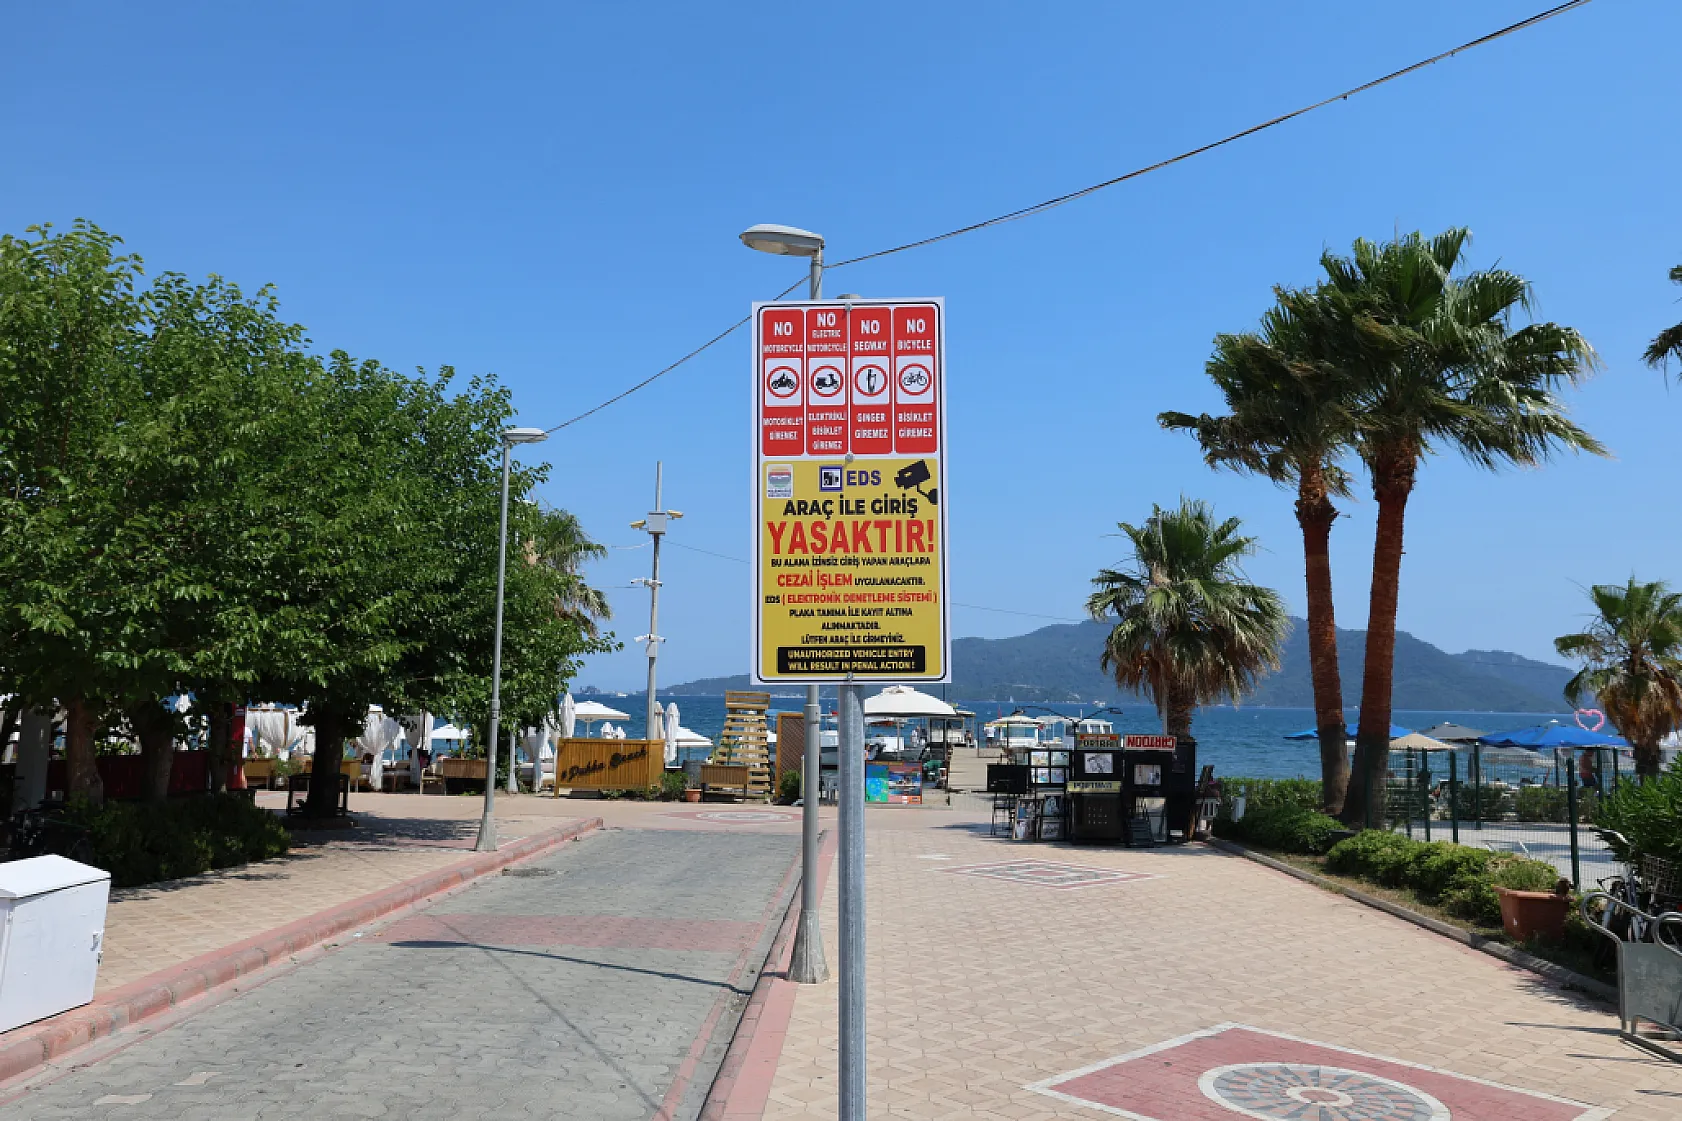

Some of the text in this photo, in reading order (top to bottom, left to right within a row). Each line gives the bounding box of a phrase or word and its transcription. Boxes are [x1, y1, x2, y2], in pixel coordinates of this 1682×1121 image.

[816, 312, 836, 327] NO
[774, 321, 793, 336] NO
[861, 319, 880, 334] NO
[906, 318, 926, 334] NO
[812, 329, 841, 338] ELECTRIC
[763, 344, 803, 353] MOTORCYCLE
[807, 343, 847, 352] MOTORCYCLE
[854, 341, 887, 351] SEGWAY
[897, 339, 932, 350] BICYCLE
[898, 411, 933, 422] BİSİKLET
[855, 427, 888, 439] GİREMEZ
[898, 426, 933, 438] GİREMEZ
[846, 470, 881, 486] EDS
[783, 493, 919, 519] ARAÇ İLE GİRİŞ
[767, 520, 934, 555] YASAKTIR!
[771, 558, 782, 567] BU
[784, 558, 810, 567] ALANA
[777, 569, 813, 587] CEZAİ
[816, 568, 853, 590] İŞLEM
[765, 594, 780, 604] EDS
[789, 608, 815, 617] PLAKA
[787, 648, 915, 659] UNAUTHORIZED VEHICLE ENTRY
[788, 662, 808, 671] WILL
[810, 661, 840, 671] RESULT
[841, 661, 850, 670] IN
[851, 661, 878, 670] PENAL
[1125, 736, 1176, 749] CARTOON
